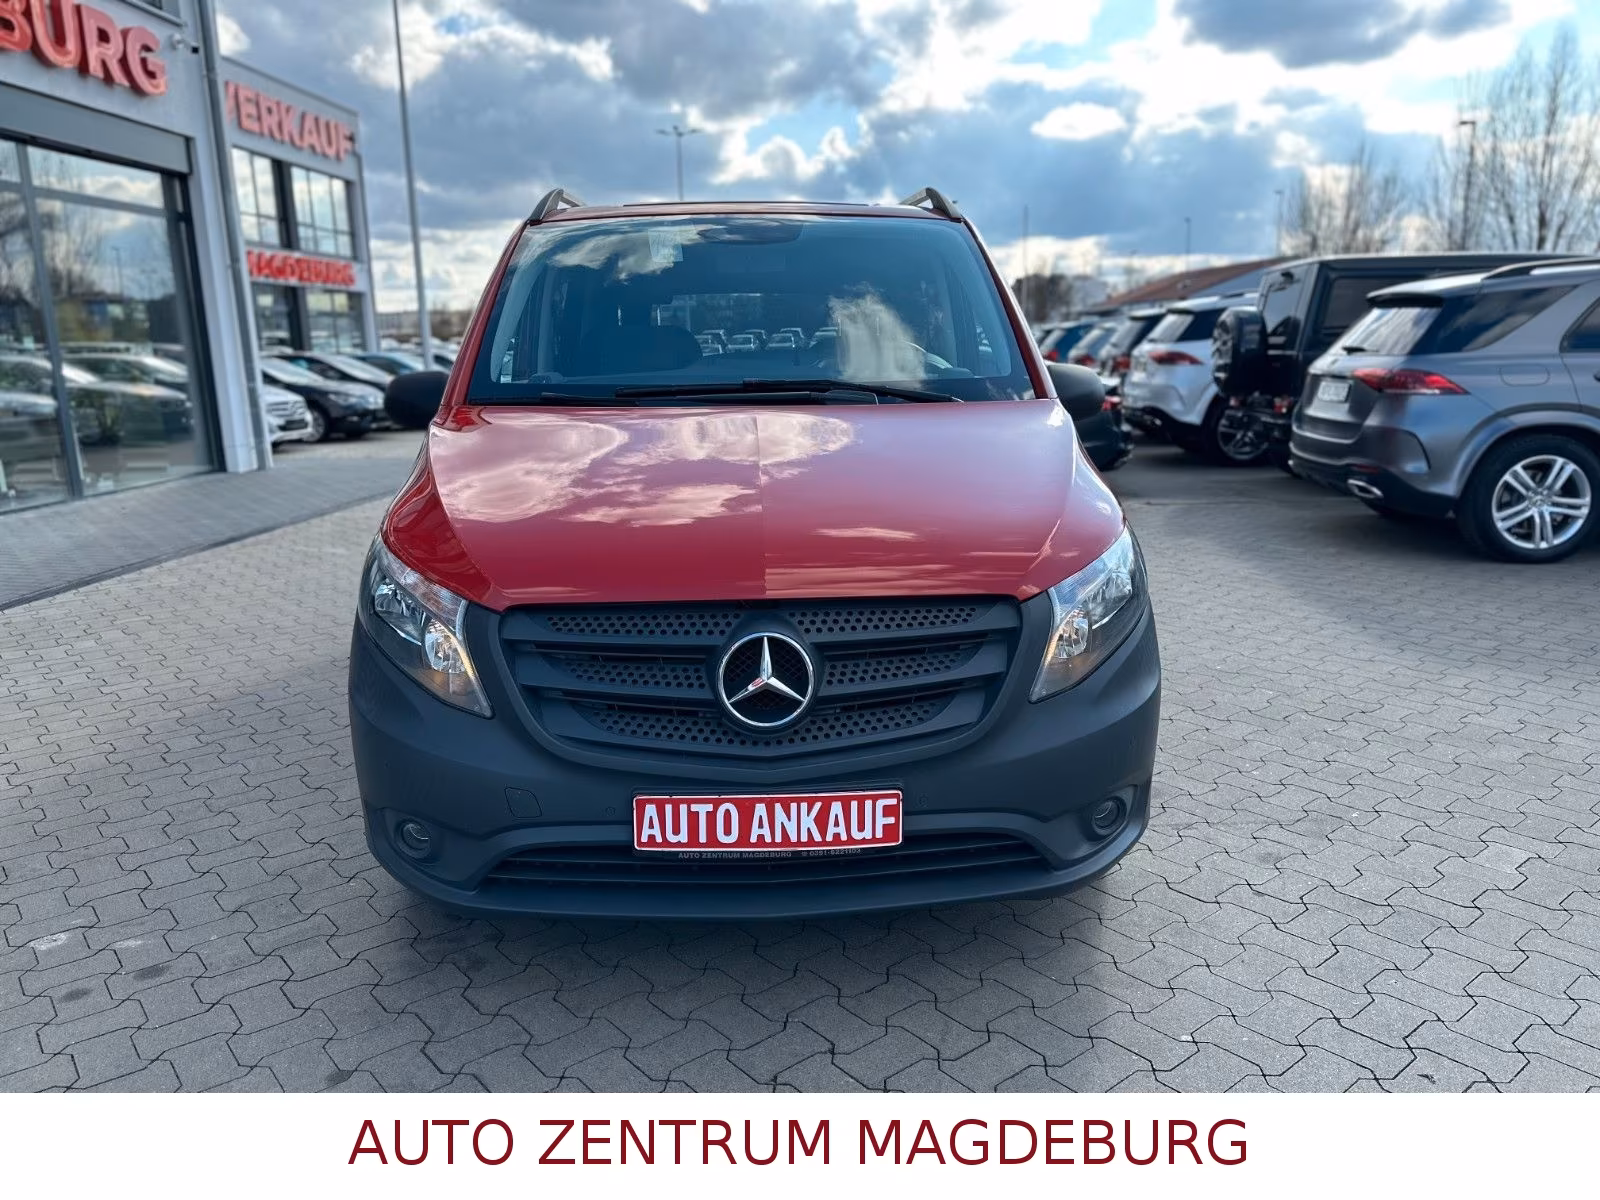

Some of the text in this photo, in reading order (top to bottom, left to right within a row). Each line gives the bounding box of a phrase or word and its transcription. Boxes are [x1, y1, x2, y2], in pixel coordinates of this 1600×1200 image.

[641, 797, 898, 844] AUTO ANKAUF
[701, 851, 741, 859] ZENTRUM
[742, 851, 792, 859] MAGDEBURG
